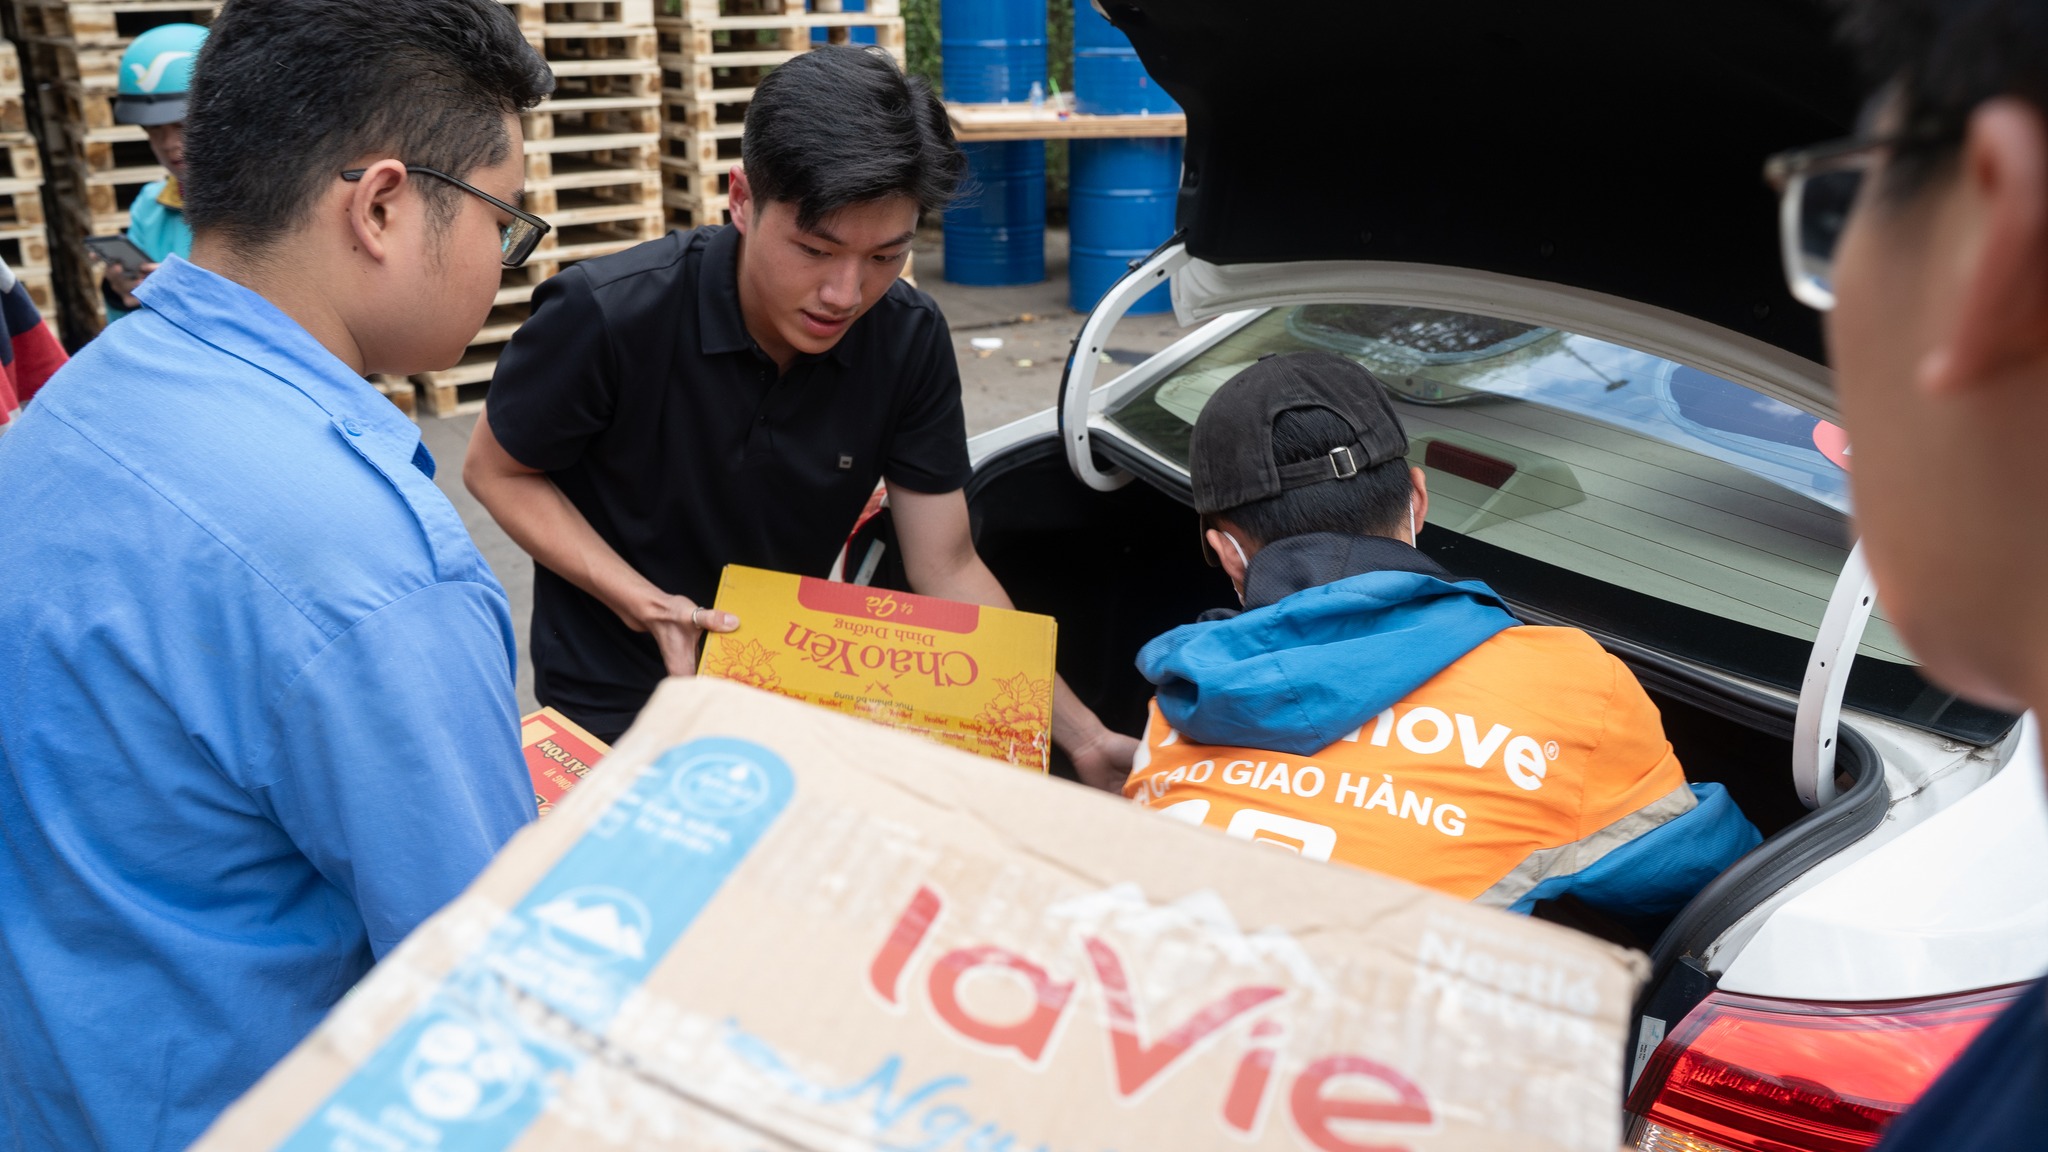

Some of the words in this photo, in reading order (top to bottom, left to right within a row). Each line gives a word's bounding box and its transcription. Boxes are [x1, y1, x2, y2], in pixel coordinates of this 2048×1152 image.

[864, 594, 898, 618] Gà
[833, 618, 889, 640] Dưỡng
[894, 629, 936, 648] Dinh
[833, 691, 854, 701] sung
[535, 738, 572, 763] TÔM
[542, 767, 558, 779] VỊ
[562, 757, 592, 777] HÁI
[552, 774, 577, 792] ƯƠNG
[1150, 759, 1216, 798] CAO
[1222, 760, 1326, 798] GIAO
[1334, 773, 1468, 838] HÀNG
